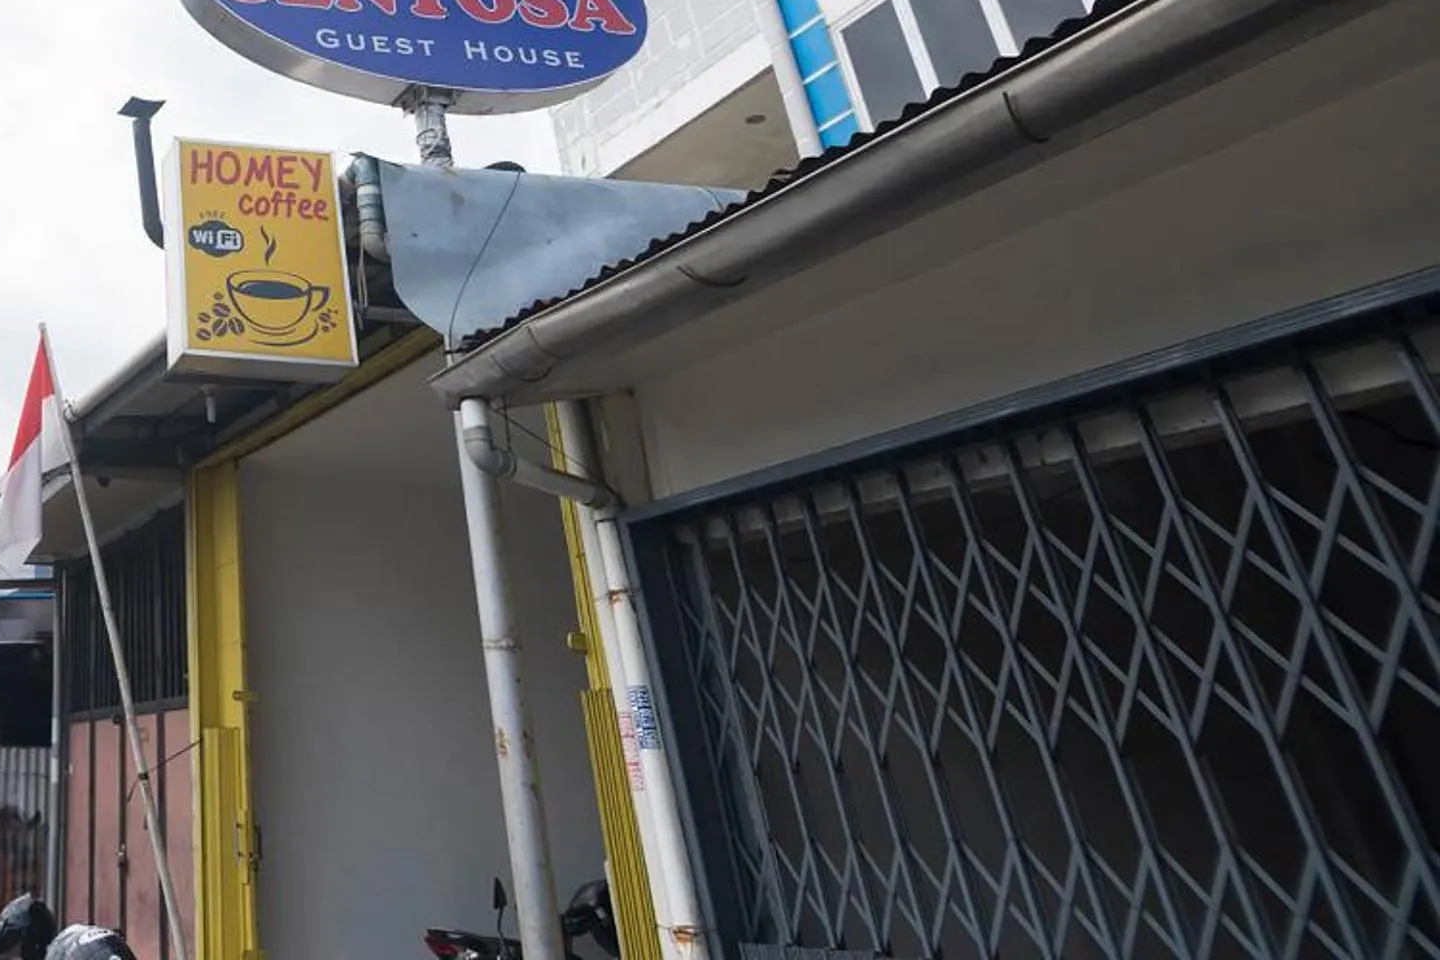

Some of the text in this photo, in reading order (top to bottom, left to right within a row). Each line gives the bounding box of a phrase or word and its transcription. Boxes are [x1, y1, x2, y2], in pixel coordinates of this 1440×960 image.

[316, 28, 585, 69] GUEST HOUSE
[190, 149, 323, 192] HOMEY
[238, 191, 329, 221] coffee
